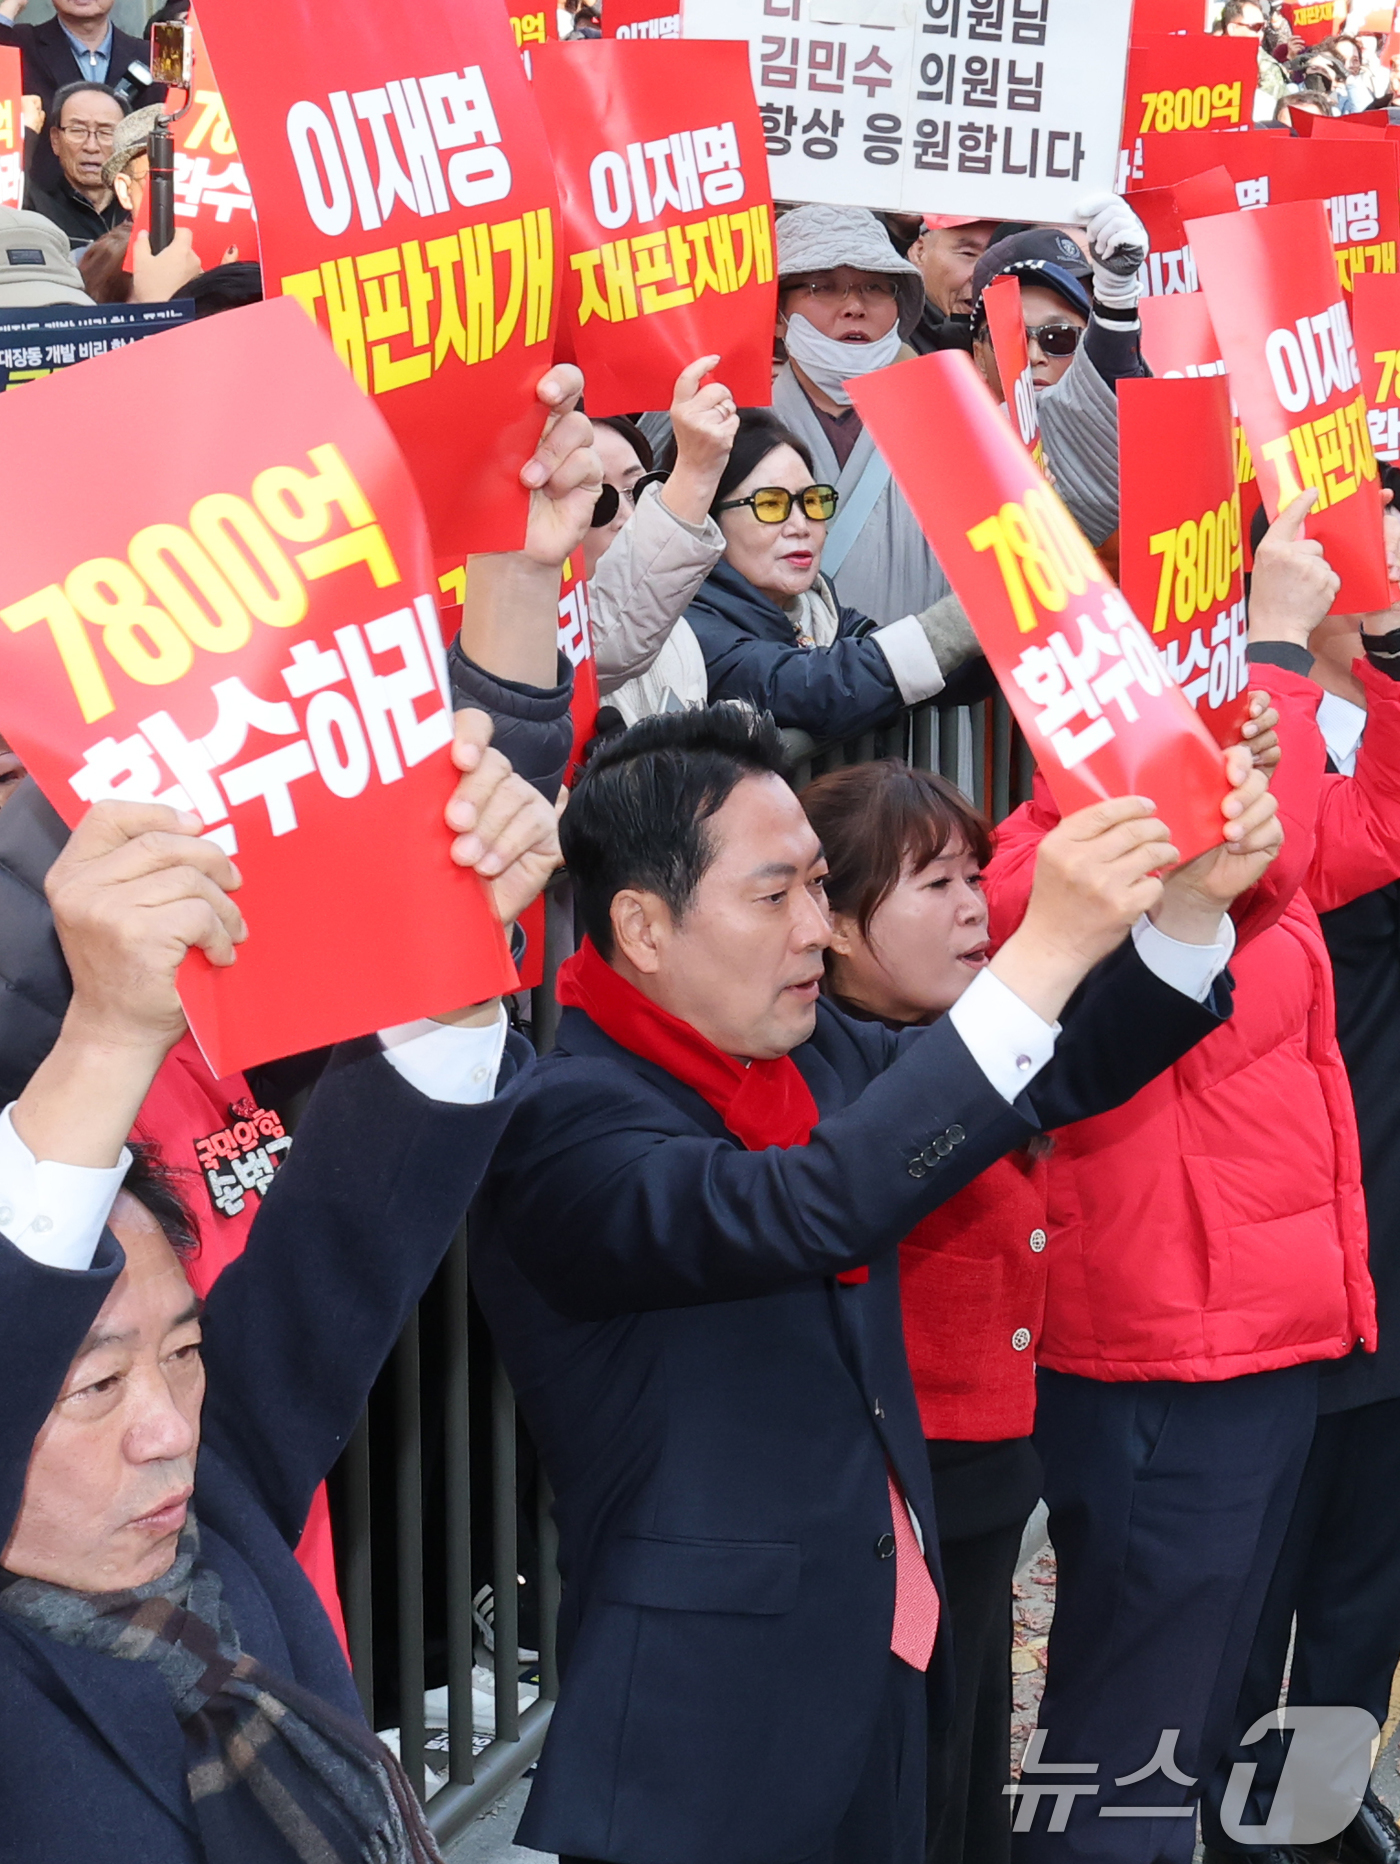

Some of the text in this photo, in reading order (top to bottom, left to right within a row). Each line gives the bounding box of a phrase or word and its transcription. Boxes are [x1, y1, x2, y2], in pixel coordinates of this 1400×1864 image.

[922, 0, 1048, 46] 의원님
[760, 35, 1043, 112] 김민수 의원님
[1139, 81, 1241, 133] 7800억
[286, 65, 512, 236] 이재명
[589, 122, 745, 229] 이재명
[759, 103, 844, 160] 항상
[863, 112, 1085, 182] 응원합니다
[281, 207, 554, 396] 재판재개
[570, 204, 774, 326] 재판재개
[0, 346, 43, 368] 대장동
[46, 342, 76, 364] 개발
[0, 442, 402, 725] 7800억
[196, 1108, 285, 1170] 국민의힘
